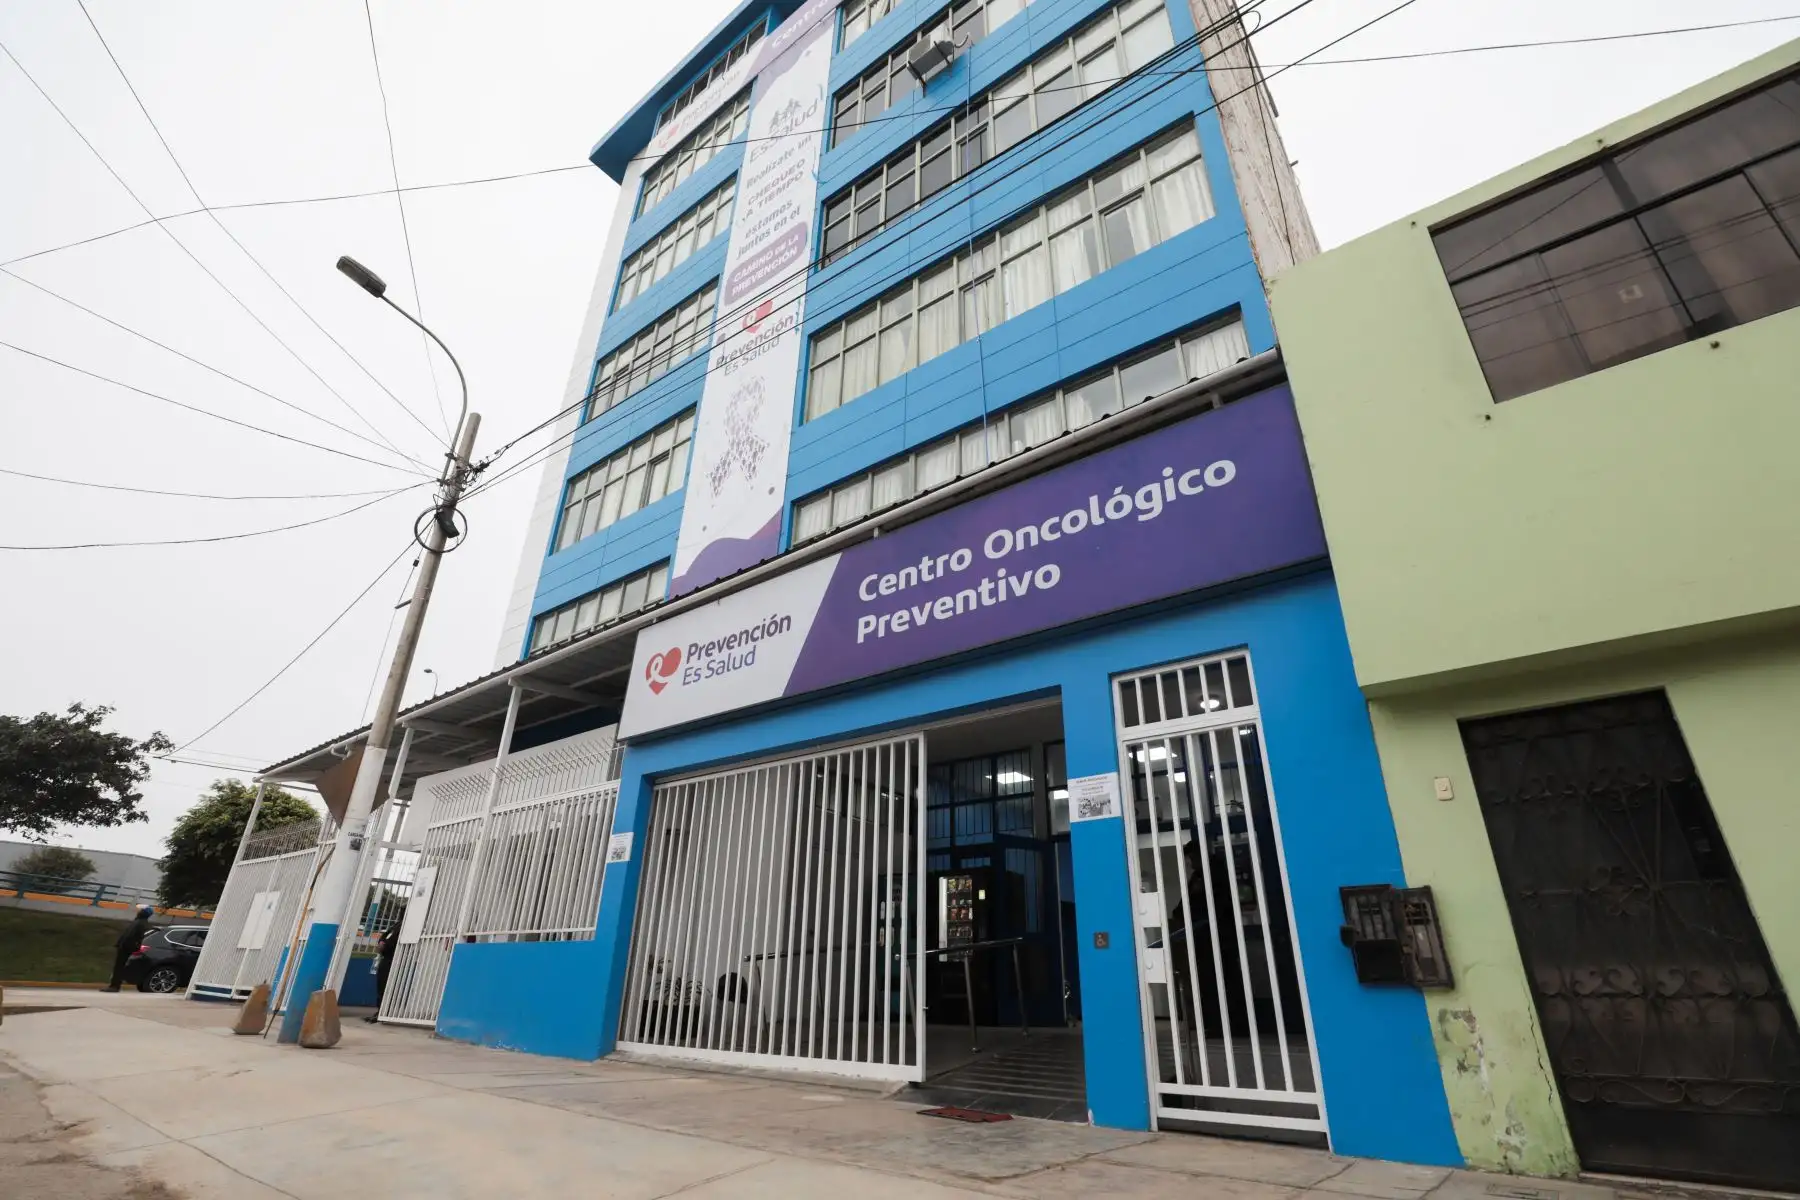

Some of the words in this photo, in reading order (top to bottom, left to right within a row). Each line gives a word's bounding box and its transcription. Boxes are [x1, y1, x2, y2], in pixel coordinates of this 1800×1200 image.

[748, 158, 805, 206] CHEQUEO
[758, 171, 804, 209] TIEMPO
[736, 229, 771, 260] juntos
[774, 216, 788, 232] en
[790, 204, 801, 219] el
[745, 200, 793, 239] estamos
[733, 250, 774, 282] CAMINO
[788, 234, 799, 246] LA
[716, 314, 794, 368] Prevención
[724, 362, 739, 376] Es
[741, 335, 780, 367] Salud
[858, 548, 973, 602] Centro
[983, 459, 1237, 560] Oncológico
[856, 563, 1061, 644] Preventivo
[686, 613, 792, 664] Prevención
[682, 666, 702, 686] Es
[704, 645, 757, 679] Salud
